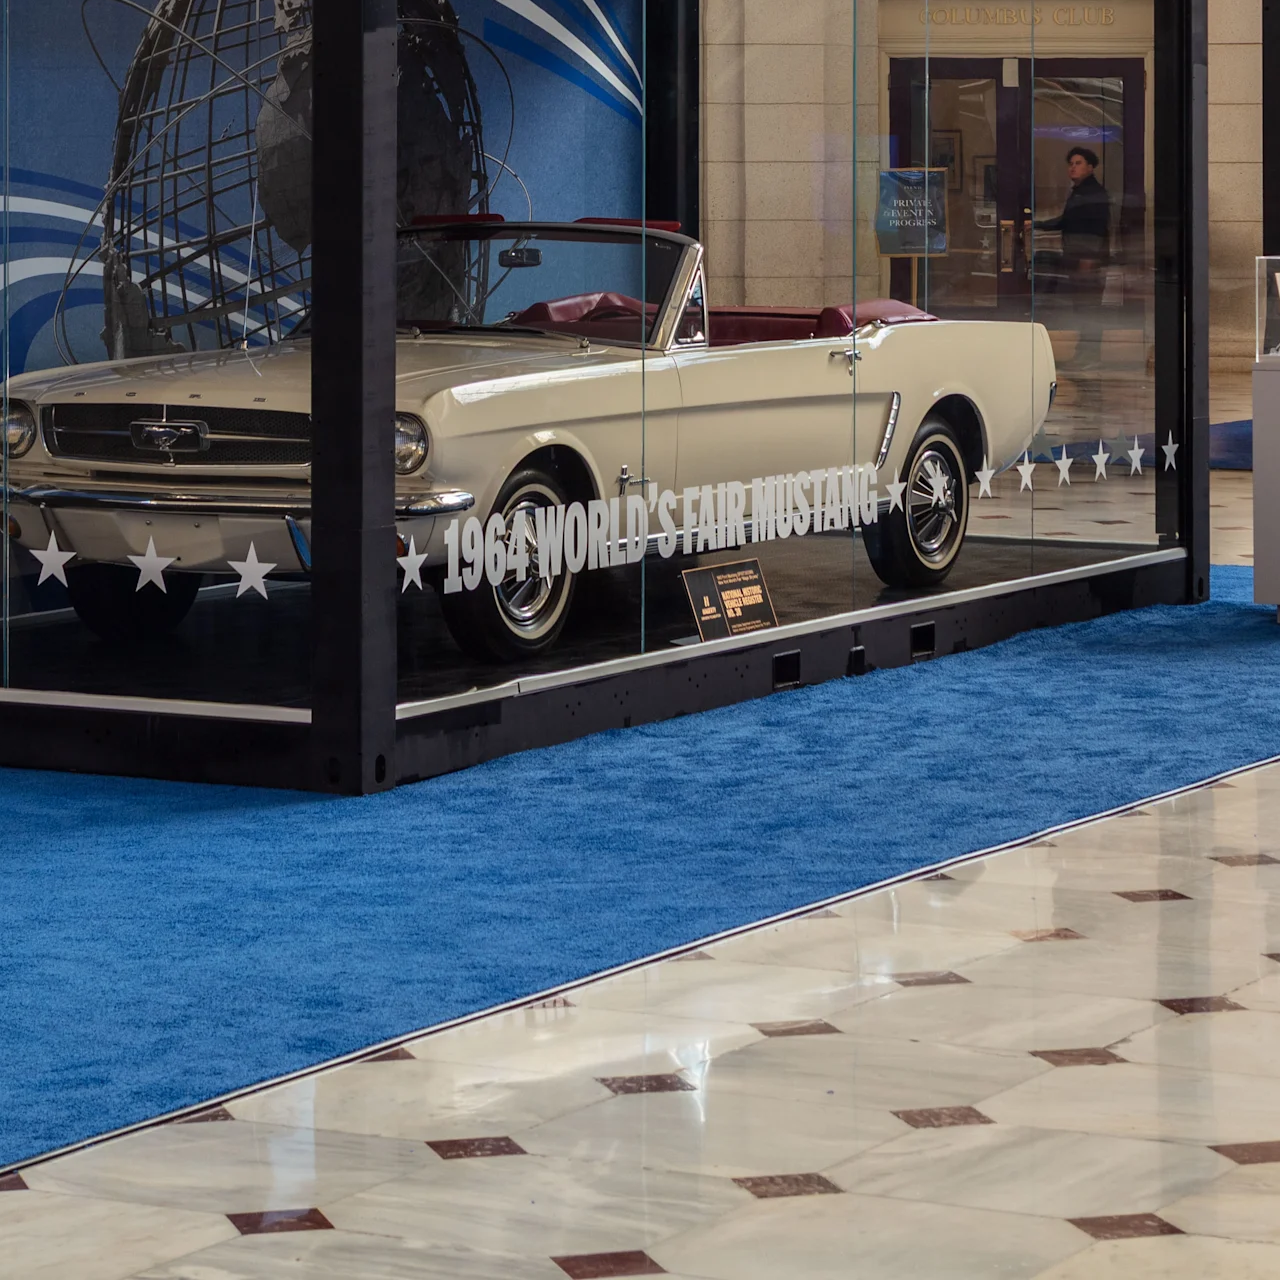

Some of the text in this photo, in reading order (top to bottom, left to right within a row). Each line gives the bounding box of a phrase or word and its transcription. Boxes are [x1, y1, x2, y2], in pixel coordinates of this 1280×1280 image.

[1052, 7, 1116, 25] CLUB
[891, 209, 924, 217] EVENT
[443, 462, 878, 594] 1964 WORLD'S FAIR MUSTANG
